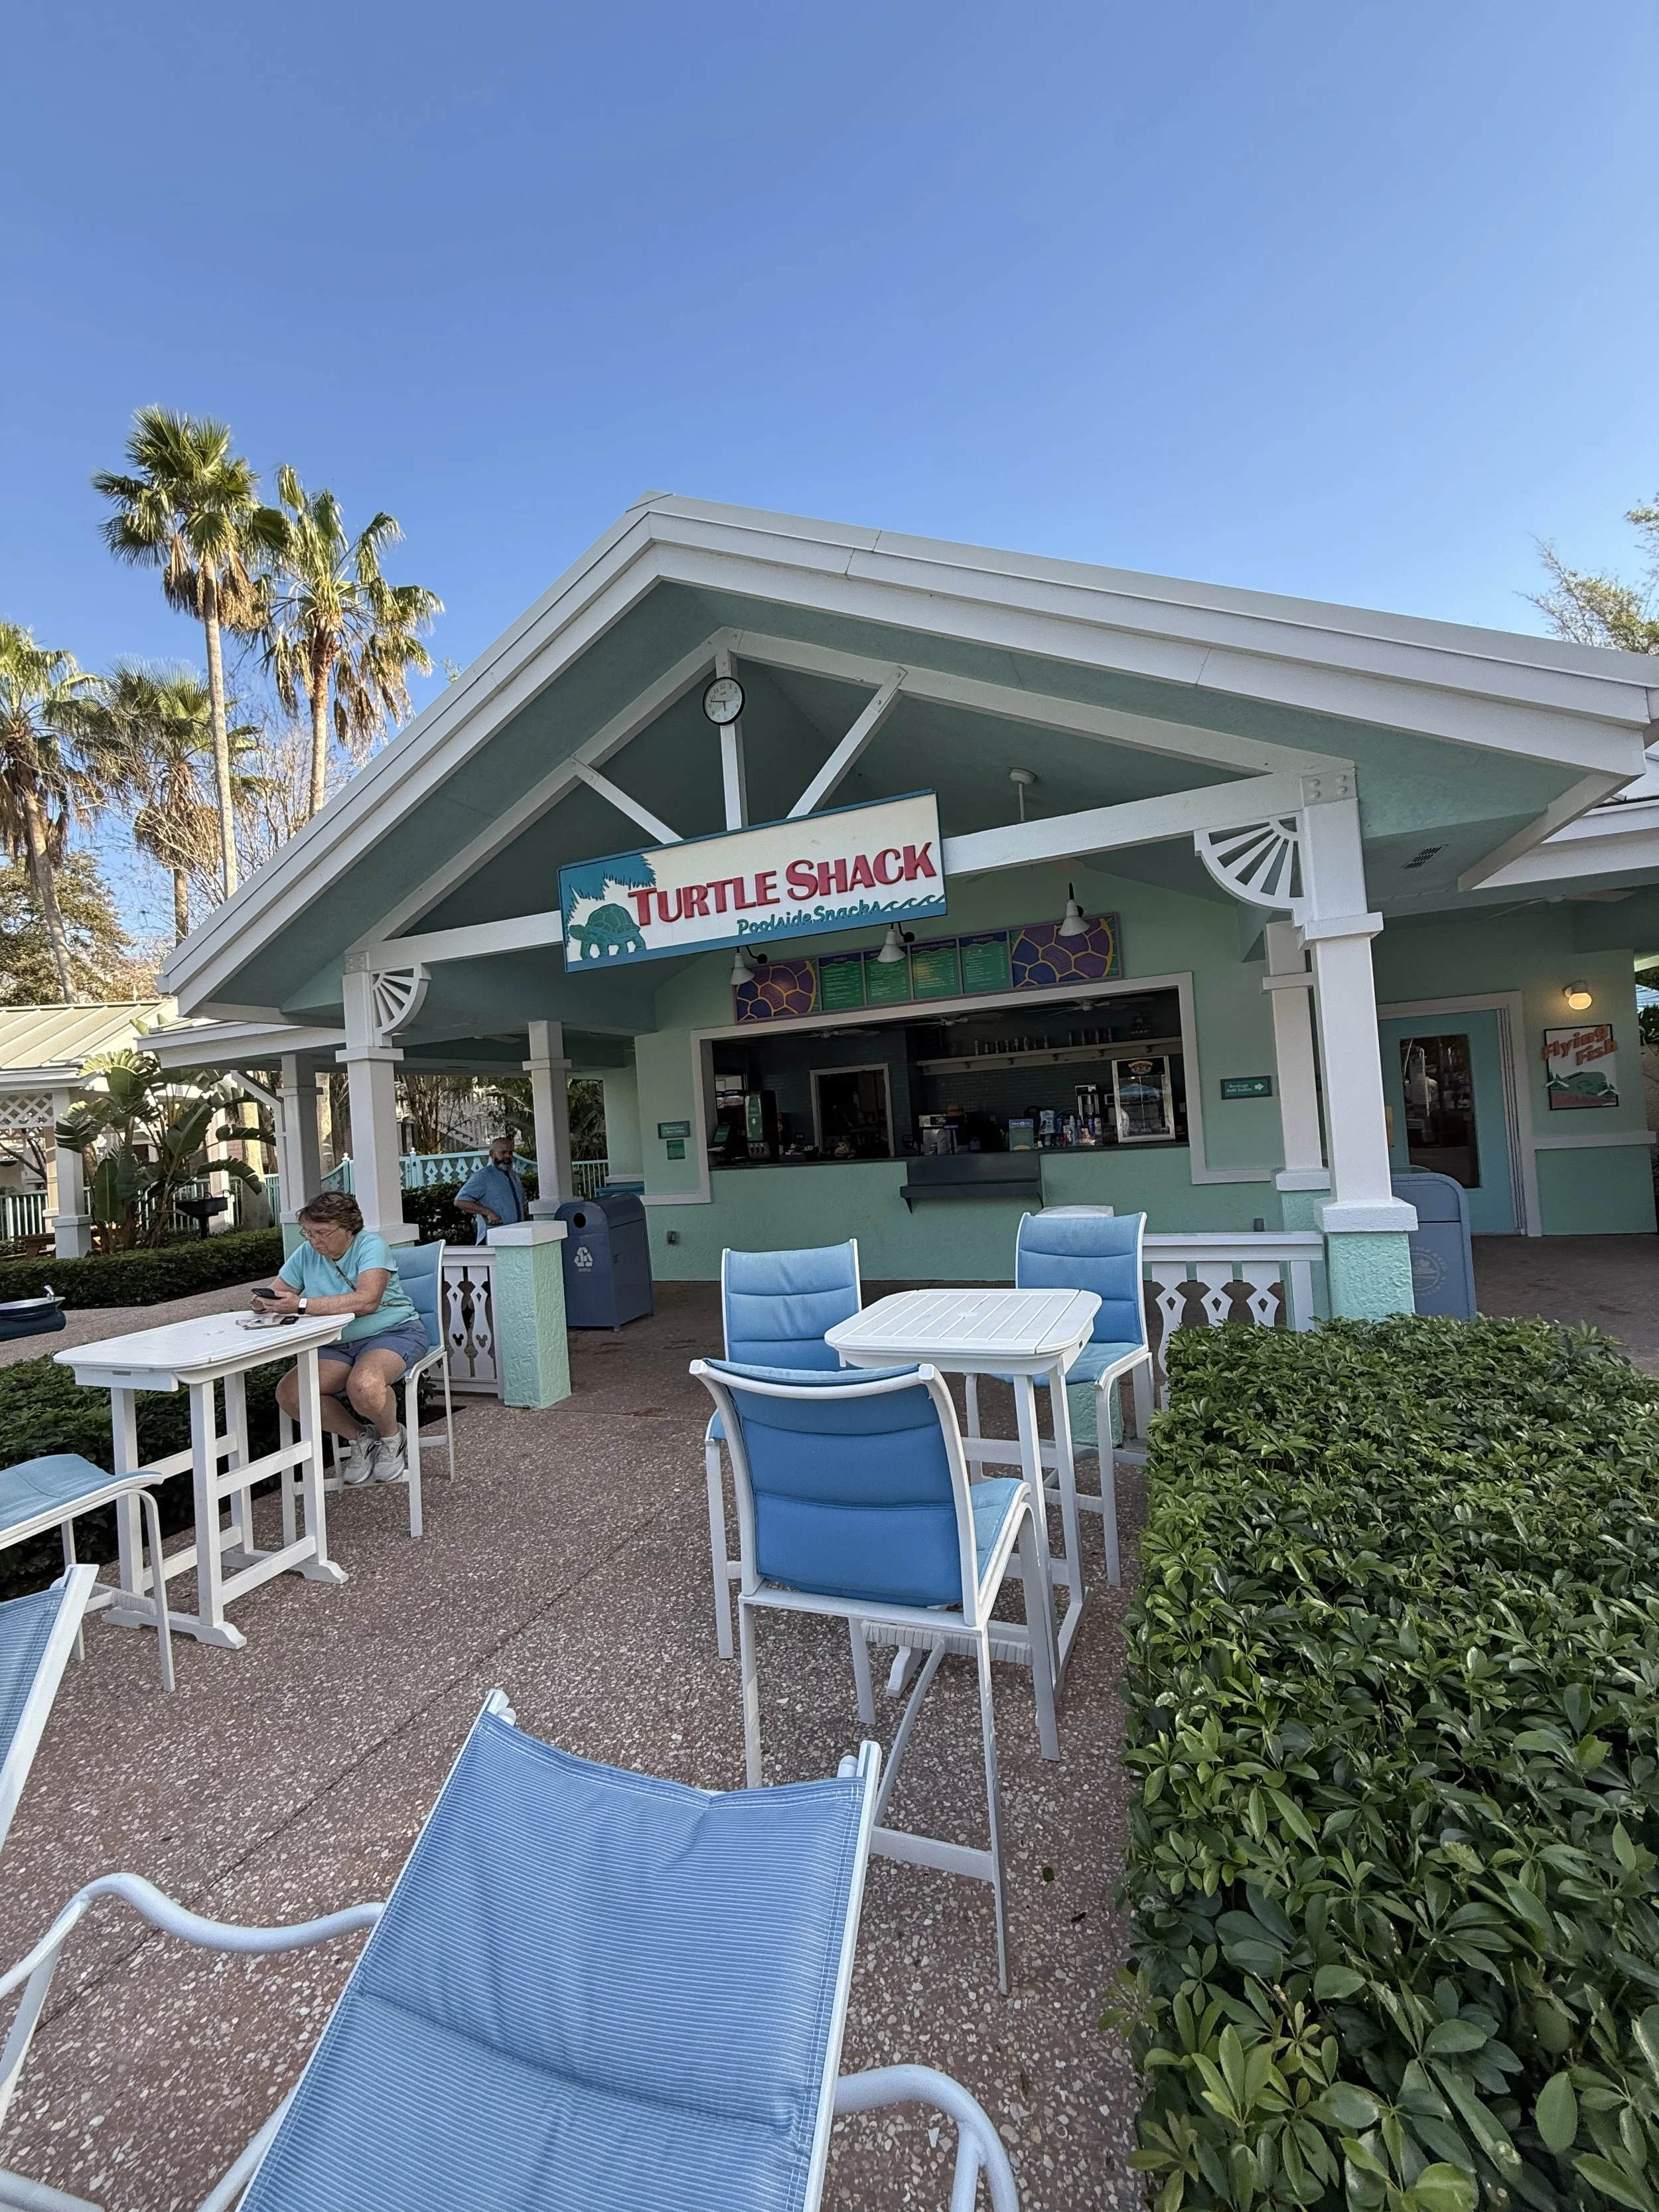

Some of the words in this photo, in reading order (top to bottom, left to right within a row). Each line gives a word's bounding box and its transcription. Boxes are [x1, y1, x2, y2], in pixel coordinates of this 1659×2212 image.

[628, 870, 780, 926] TURTLE
[786, 842, 937, 901] SHACK
[737, 909, 812, 935] Poolside
[813, 899, 881, 922] Snacks
[1541, 1025, 1609, 1061] Flying
[1575, 1039, 1618, 1066] Fish
